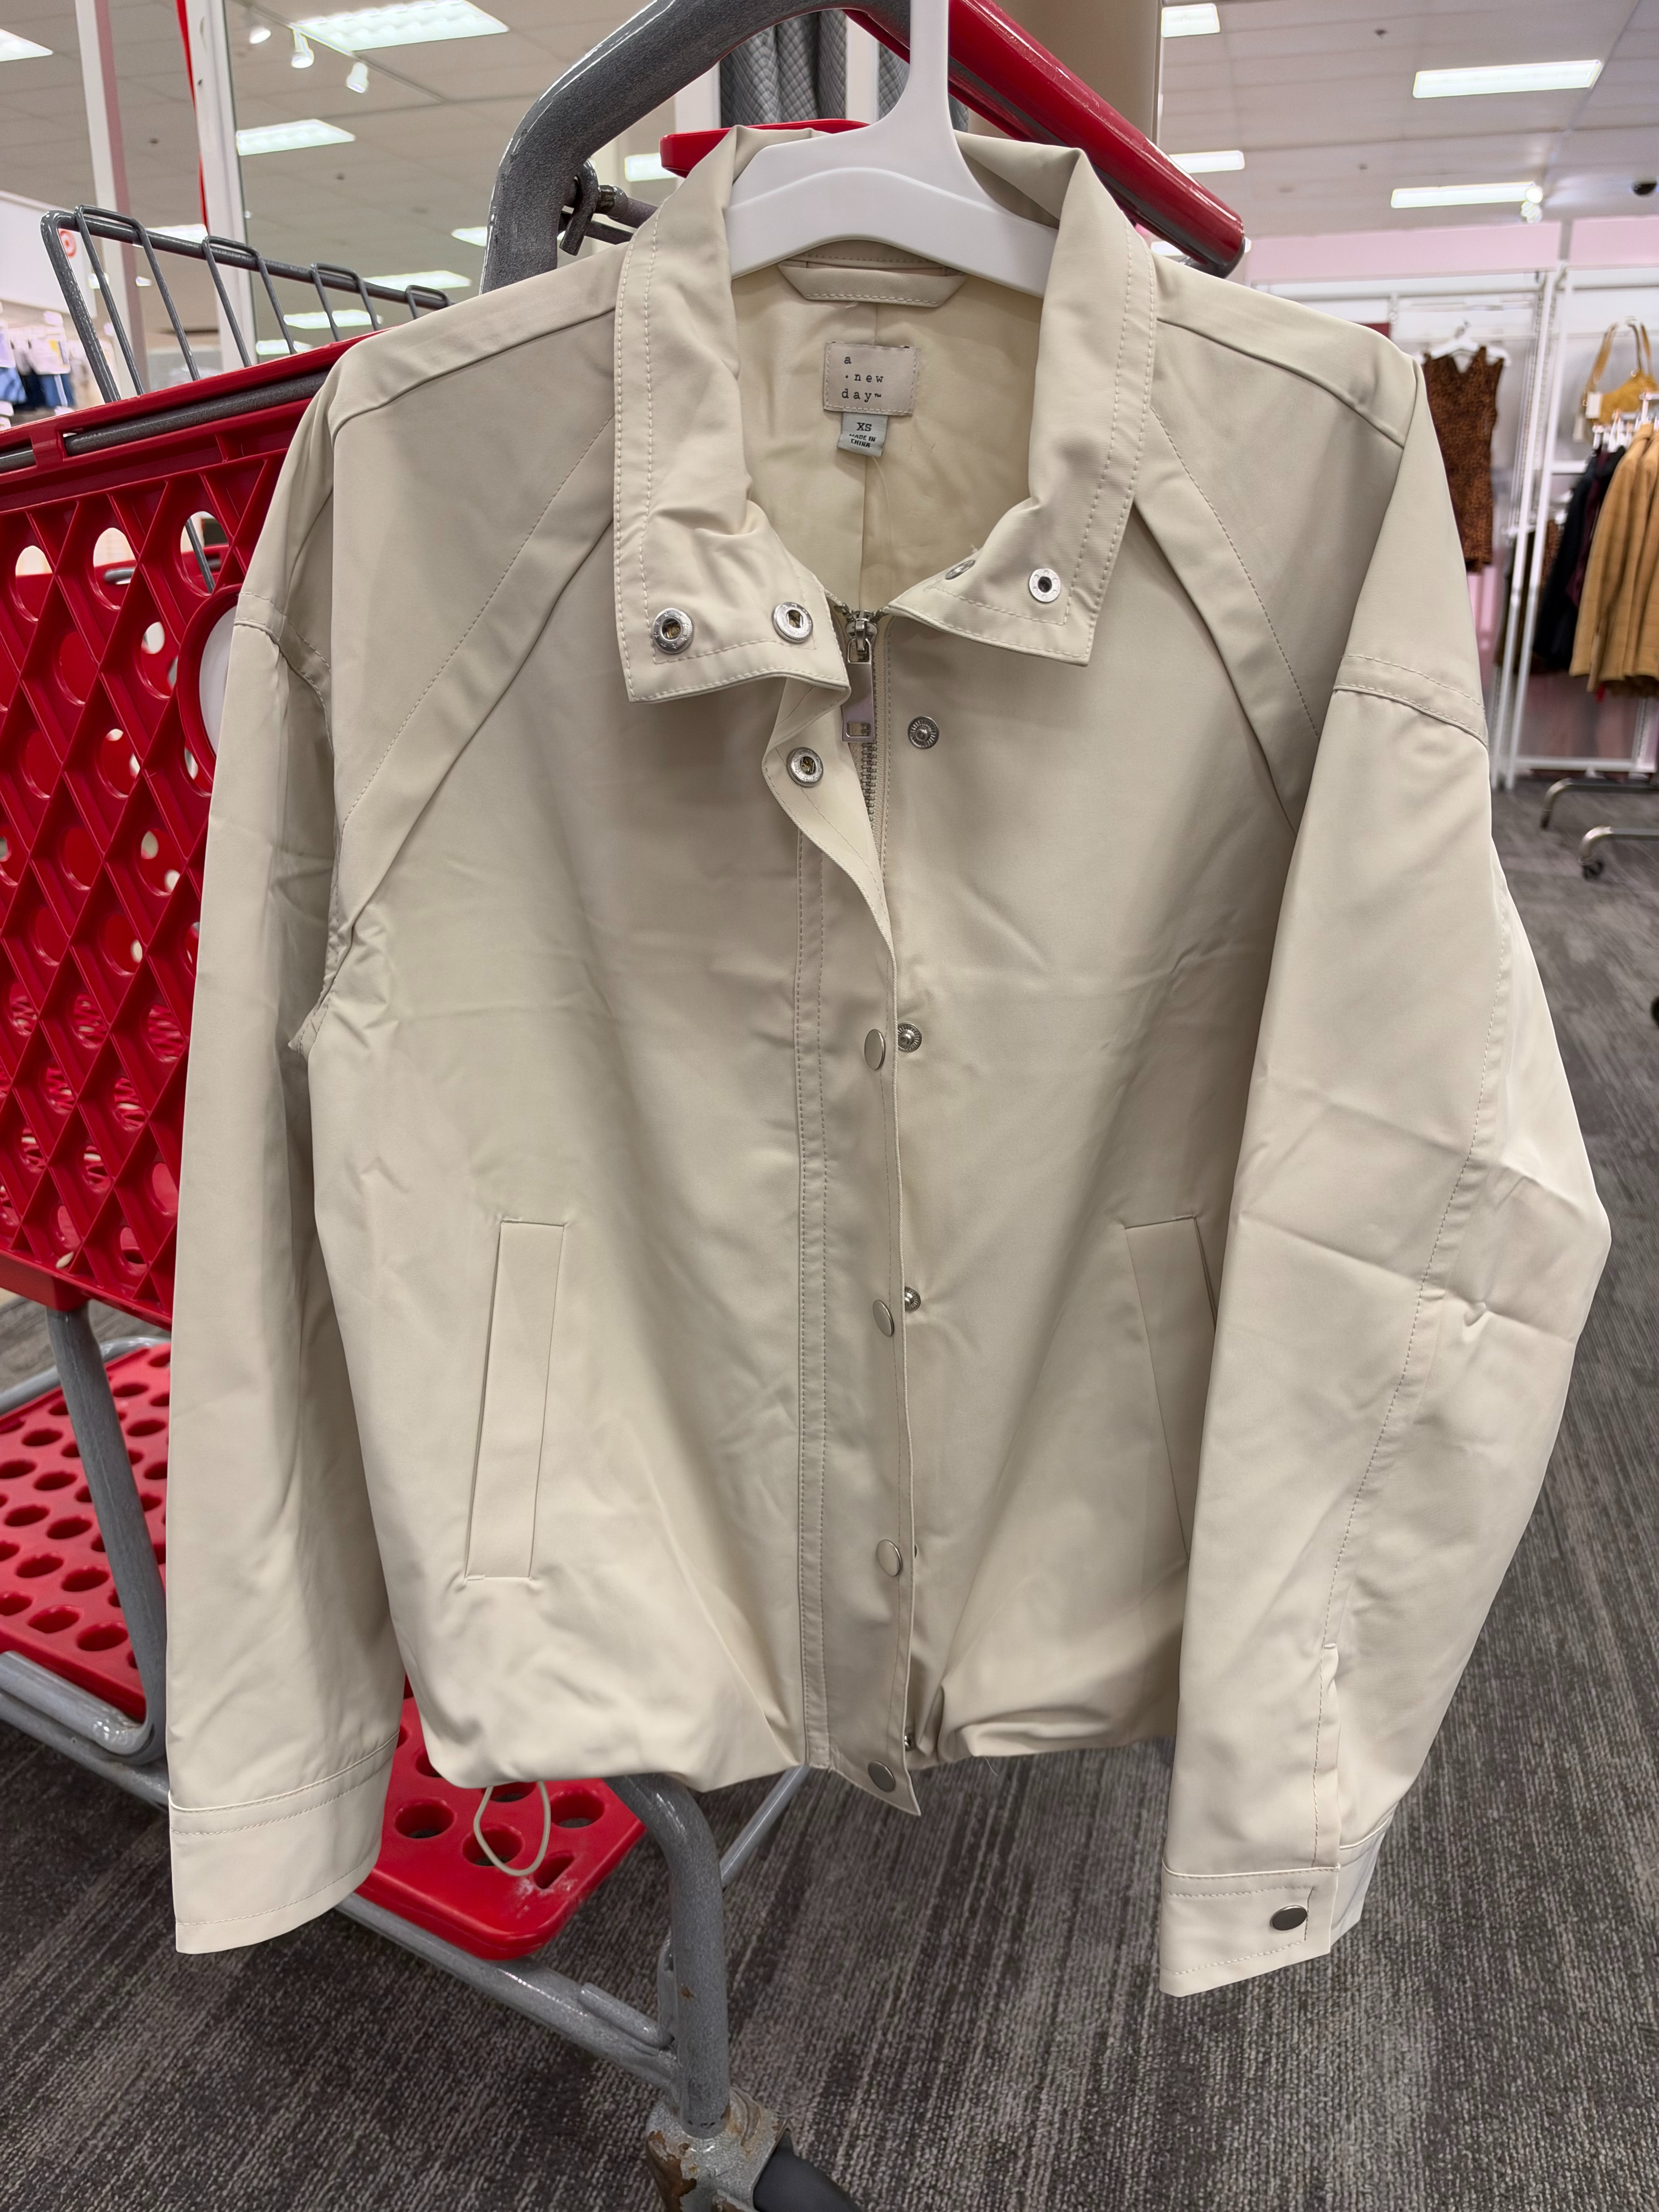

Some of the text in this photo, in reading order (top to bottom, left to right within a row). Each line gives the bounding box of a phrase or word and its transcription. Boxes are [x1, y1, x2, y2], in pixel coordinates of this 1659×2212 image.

[844, 356, 852, 364] a
[856, 422, 872, 432] XS
[850, 438, 871, 448] CHINA
